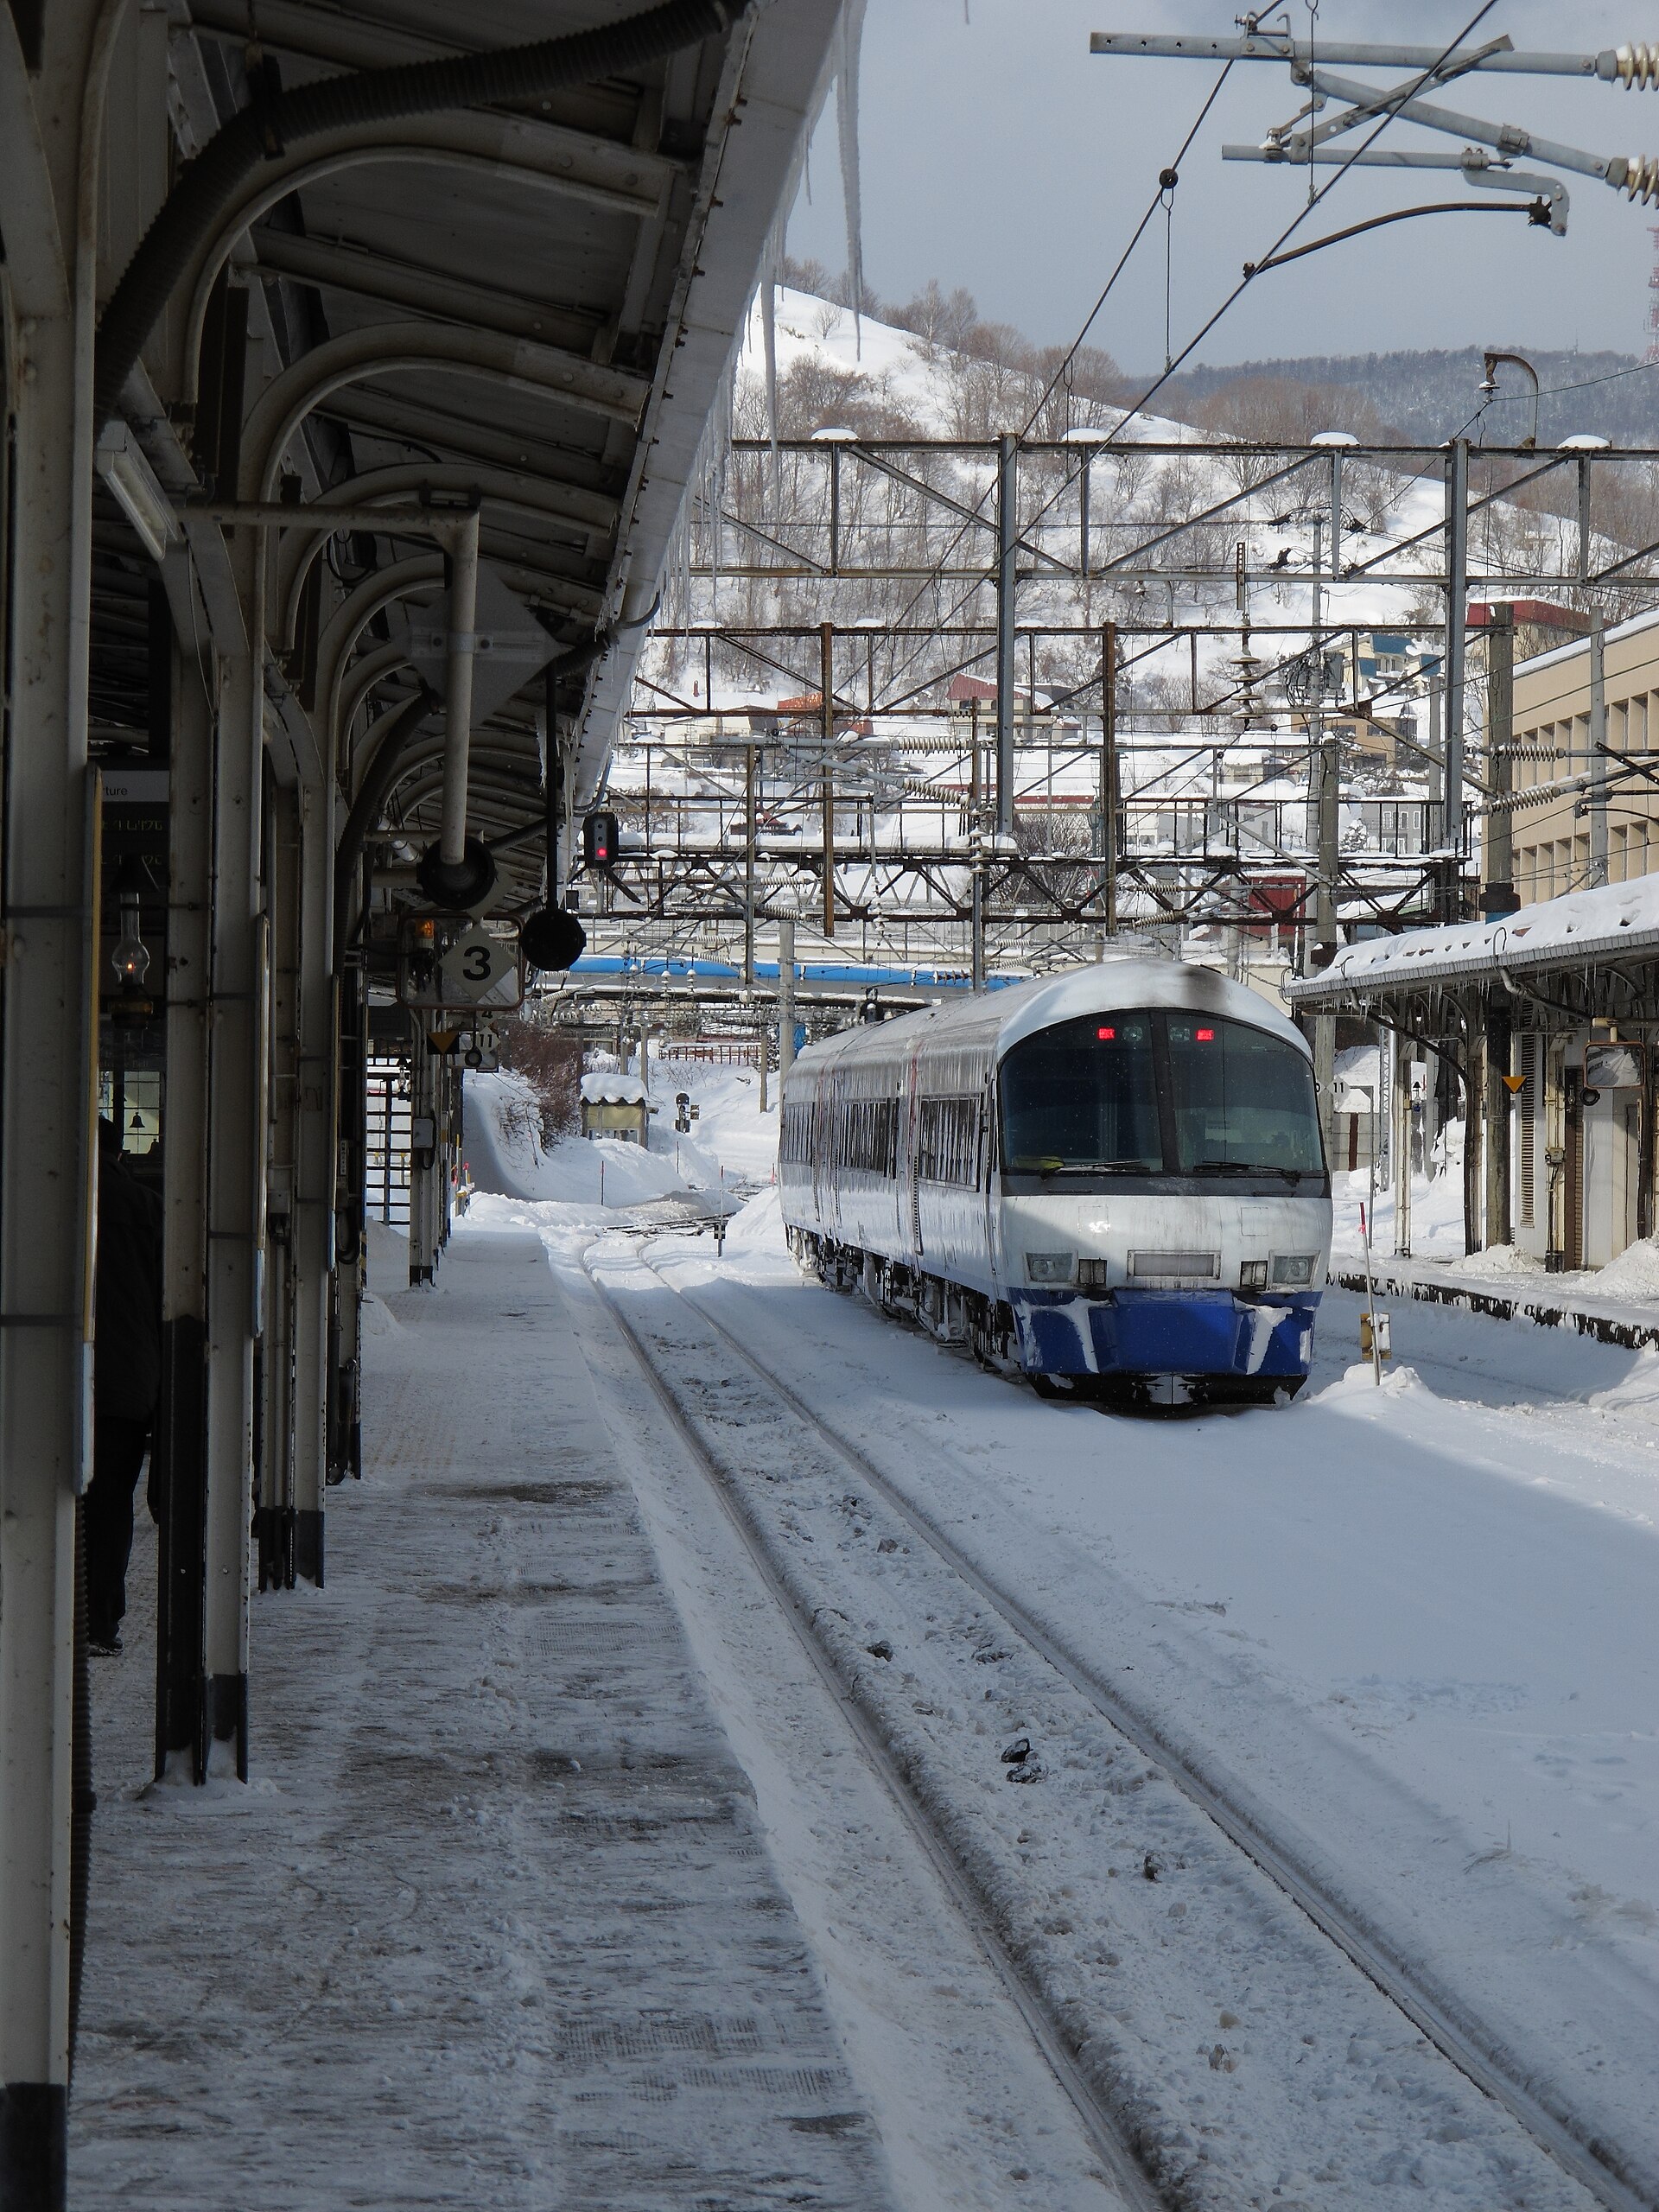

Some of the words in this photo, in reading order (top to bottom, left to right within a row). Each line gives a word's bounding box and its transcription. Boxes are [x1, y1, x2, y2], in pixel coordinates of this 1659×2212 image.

[103, 786, 128, 796] ture
[462, 945, 492, 982] 3
[480, 1034, 493, 1048] 11
[1333, 1082, 1344, 1093] 11
